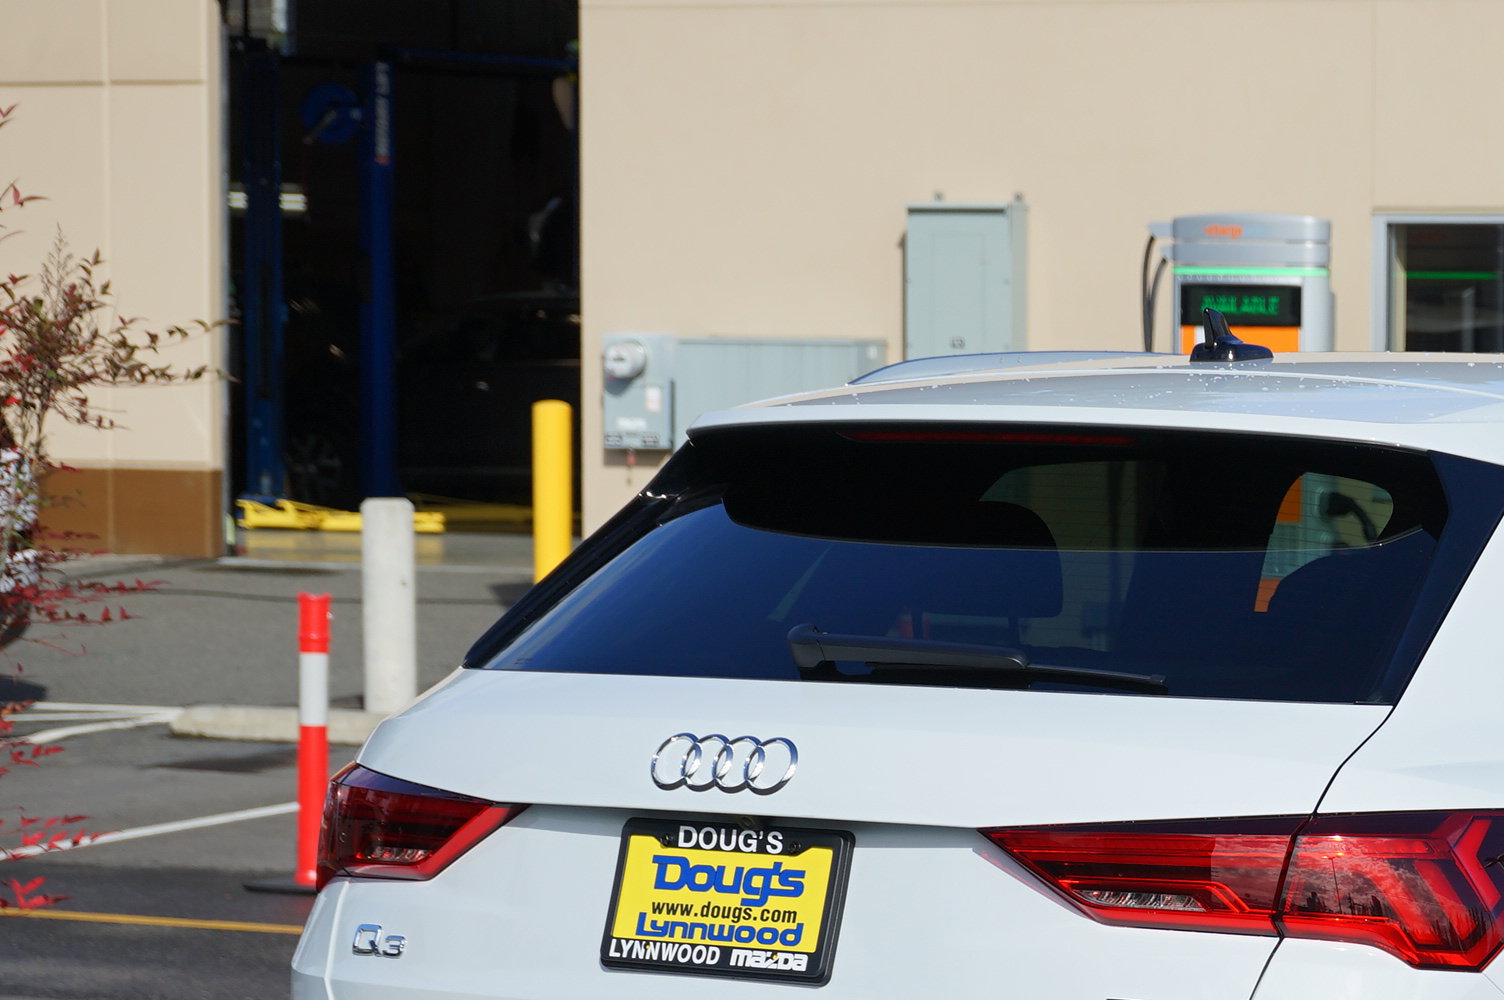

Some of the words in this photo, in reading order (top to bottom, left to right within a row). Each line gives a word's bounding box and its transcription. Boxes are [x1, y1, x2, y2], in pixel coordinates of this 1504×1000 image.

[677, 825, 783, 854] DOUG'S
[651, 854, 806, 907] Doug's
[651, 901, 798, 923] www.dougs.com
[352, 923, 408, 959] Q3
[635, 912, 804, 946] Lynnwood
[608, 938, 720, 965] LYNNWOOD
